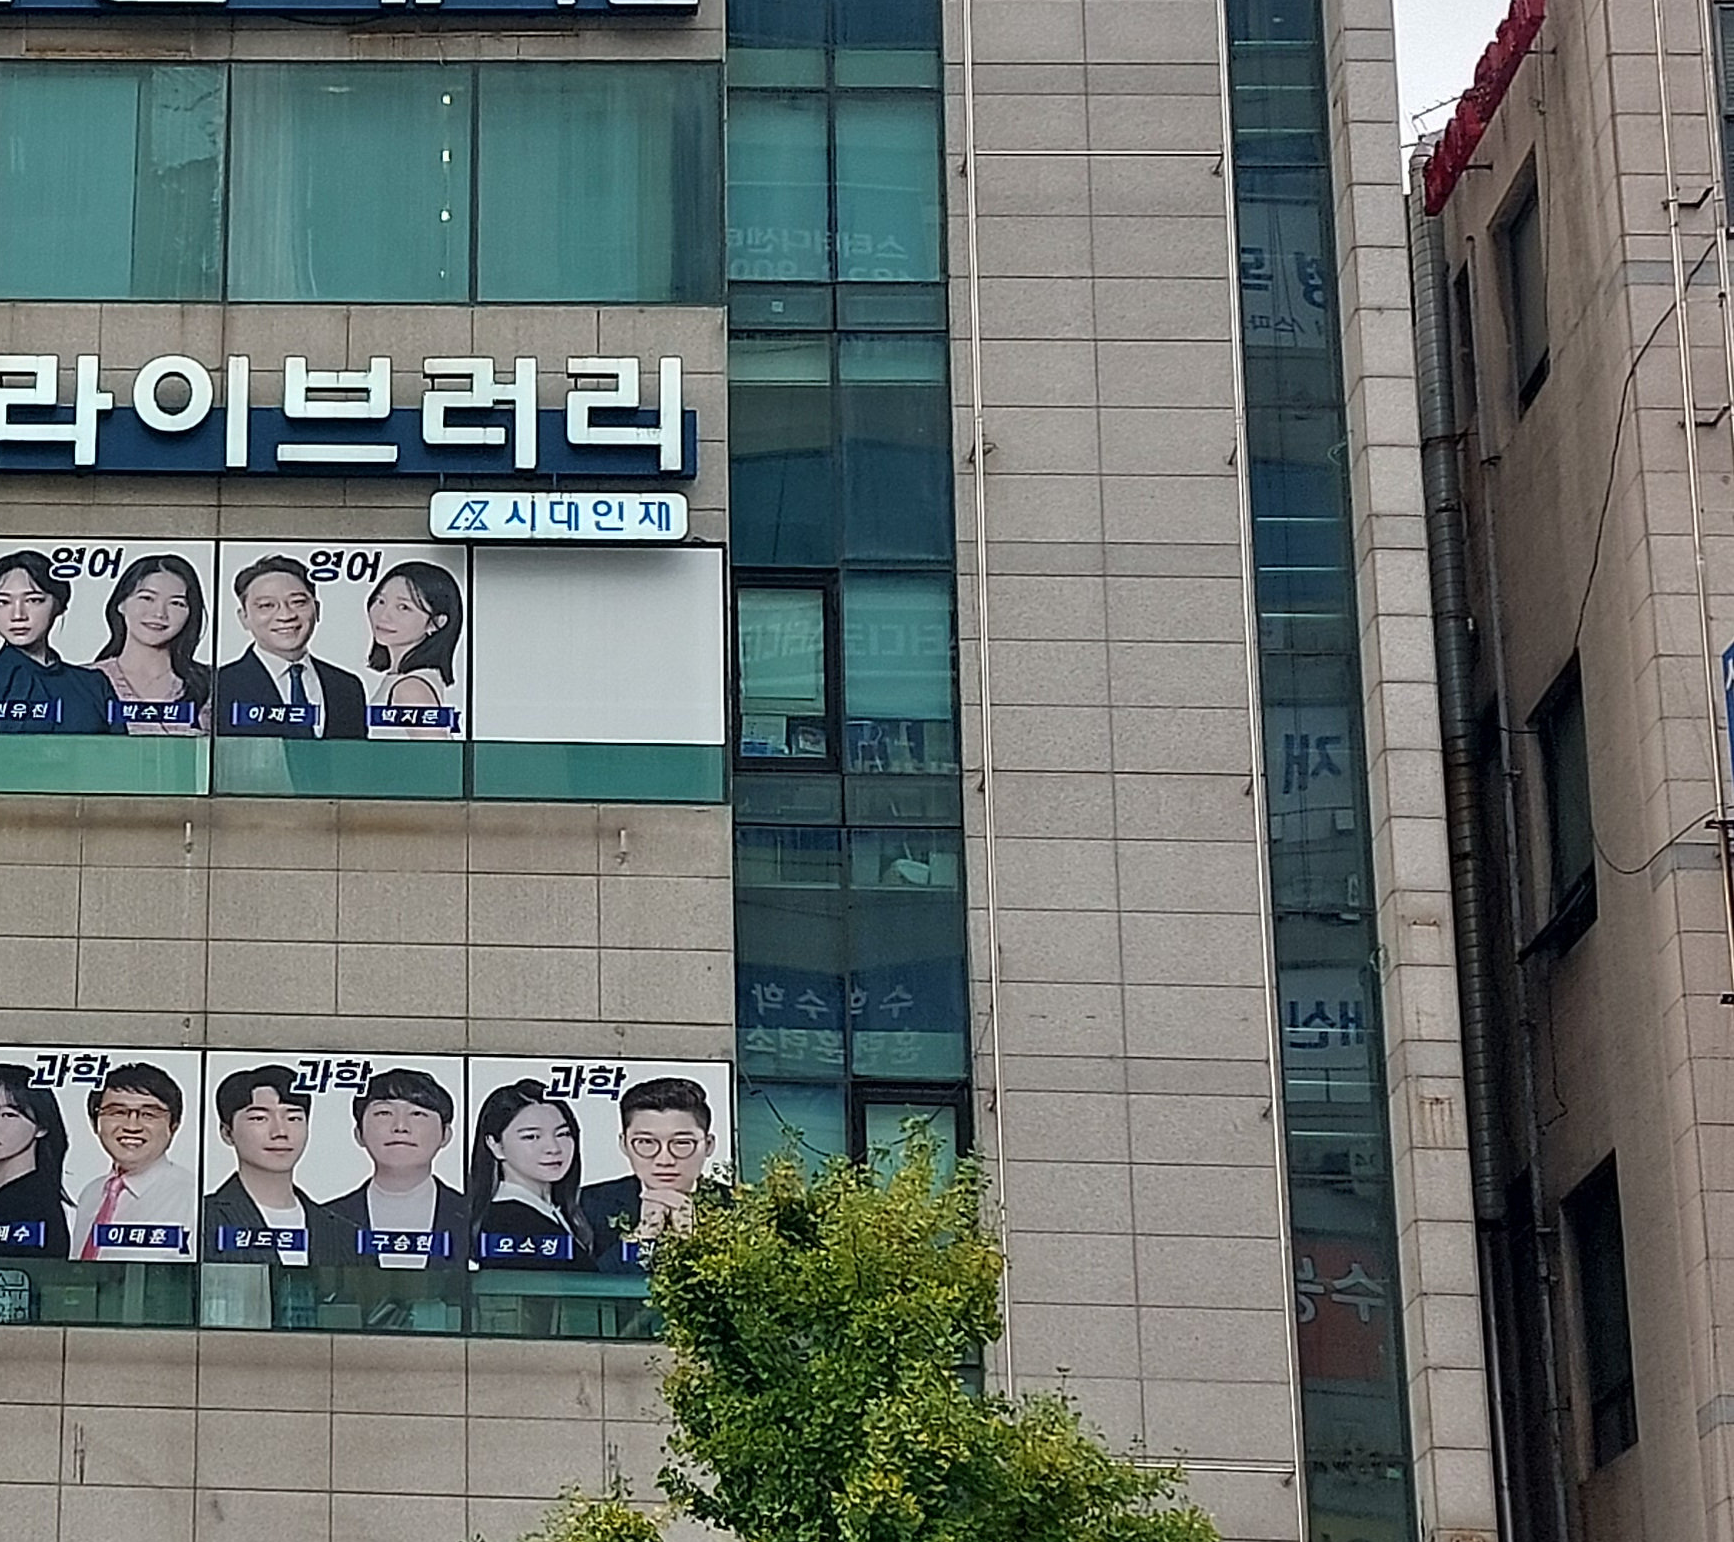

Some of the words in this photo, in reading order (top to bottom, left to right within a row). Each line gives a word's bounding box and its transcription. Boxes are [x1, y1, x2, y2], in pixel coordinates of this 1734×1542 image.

[504, 498, 671, 533] 시대인재
[49, 546, 124, 580] 영어
[307, 549, 383, 583] 영어
[29, 1052, 112, 1091] 과학
[292, 1058, 373, 1097] 과학
[545, 1064, 626, 1101] 과학
